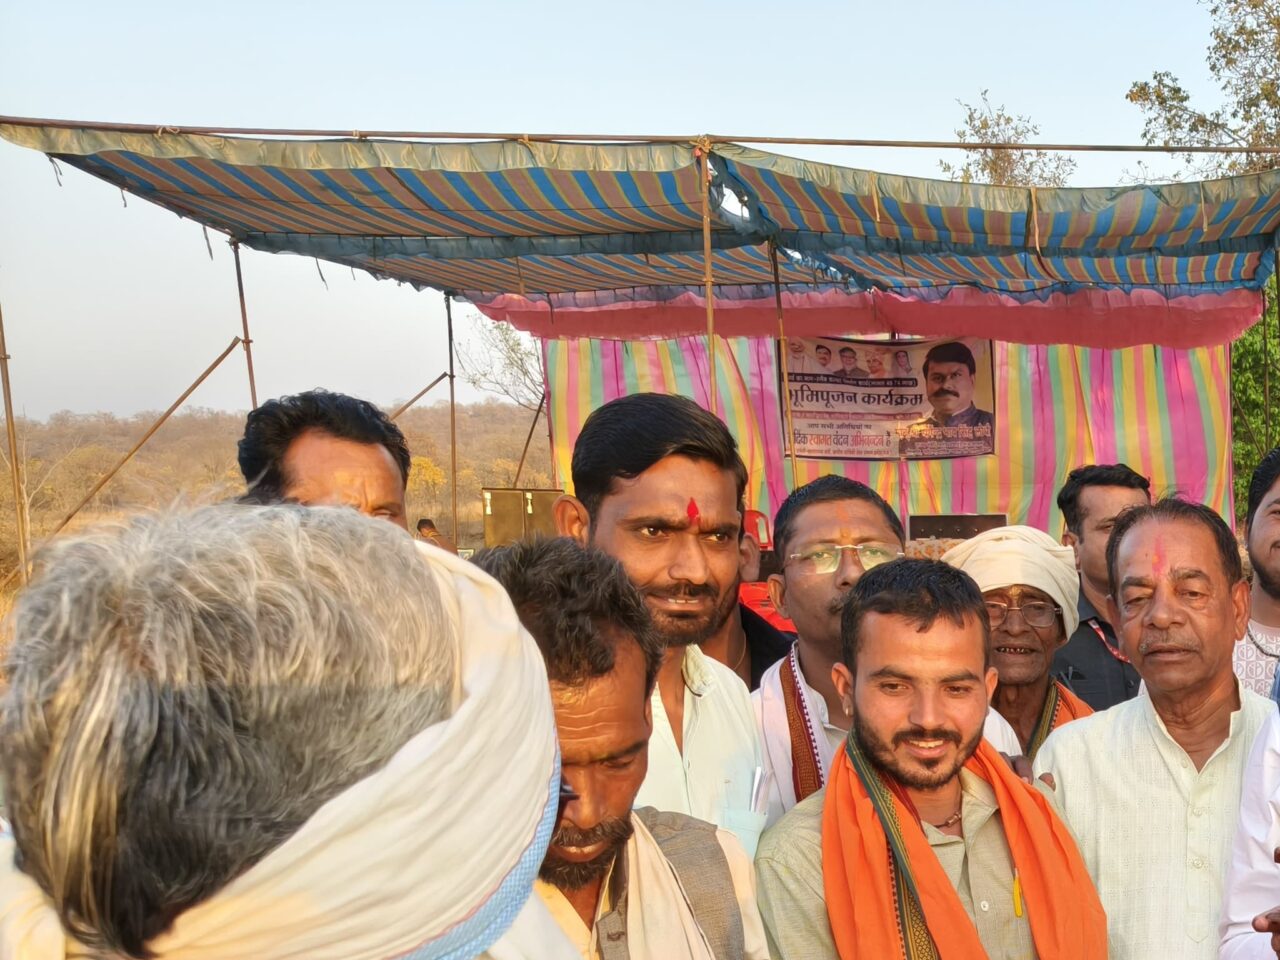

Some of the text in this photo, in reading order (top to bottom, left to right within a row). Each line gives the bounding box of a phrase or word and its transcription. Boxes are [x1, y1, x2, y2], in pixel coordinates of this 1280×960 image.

[861, 389, 923, 406] कार्यक्रम
[809, 433, 832, 446] स्वागत
[833, 430, 849, 447] वंदन
